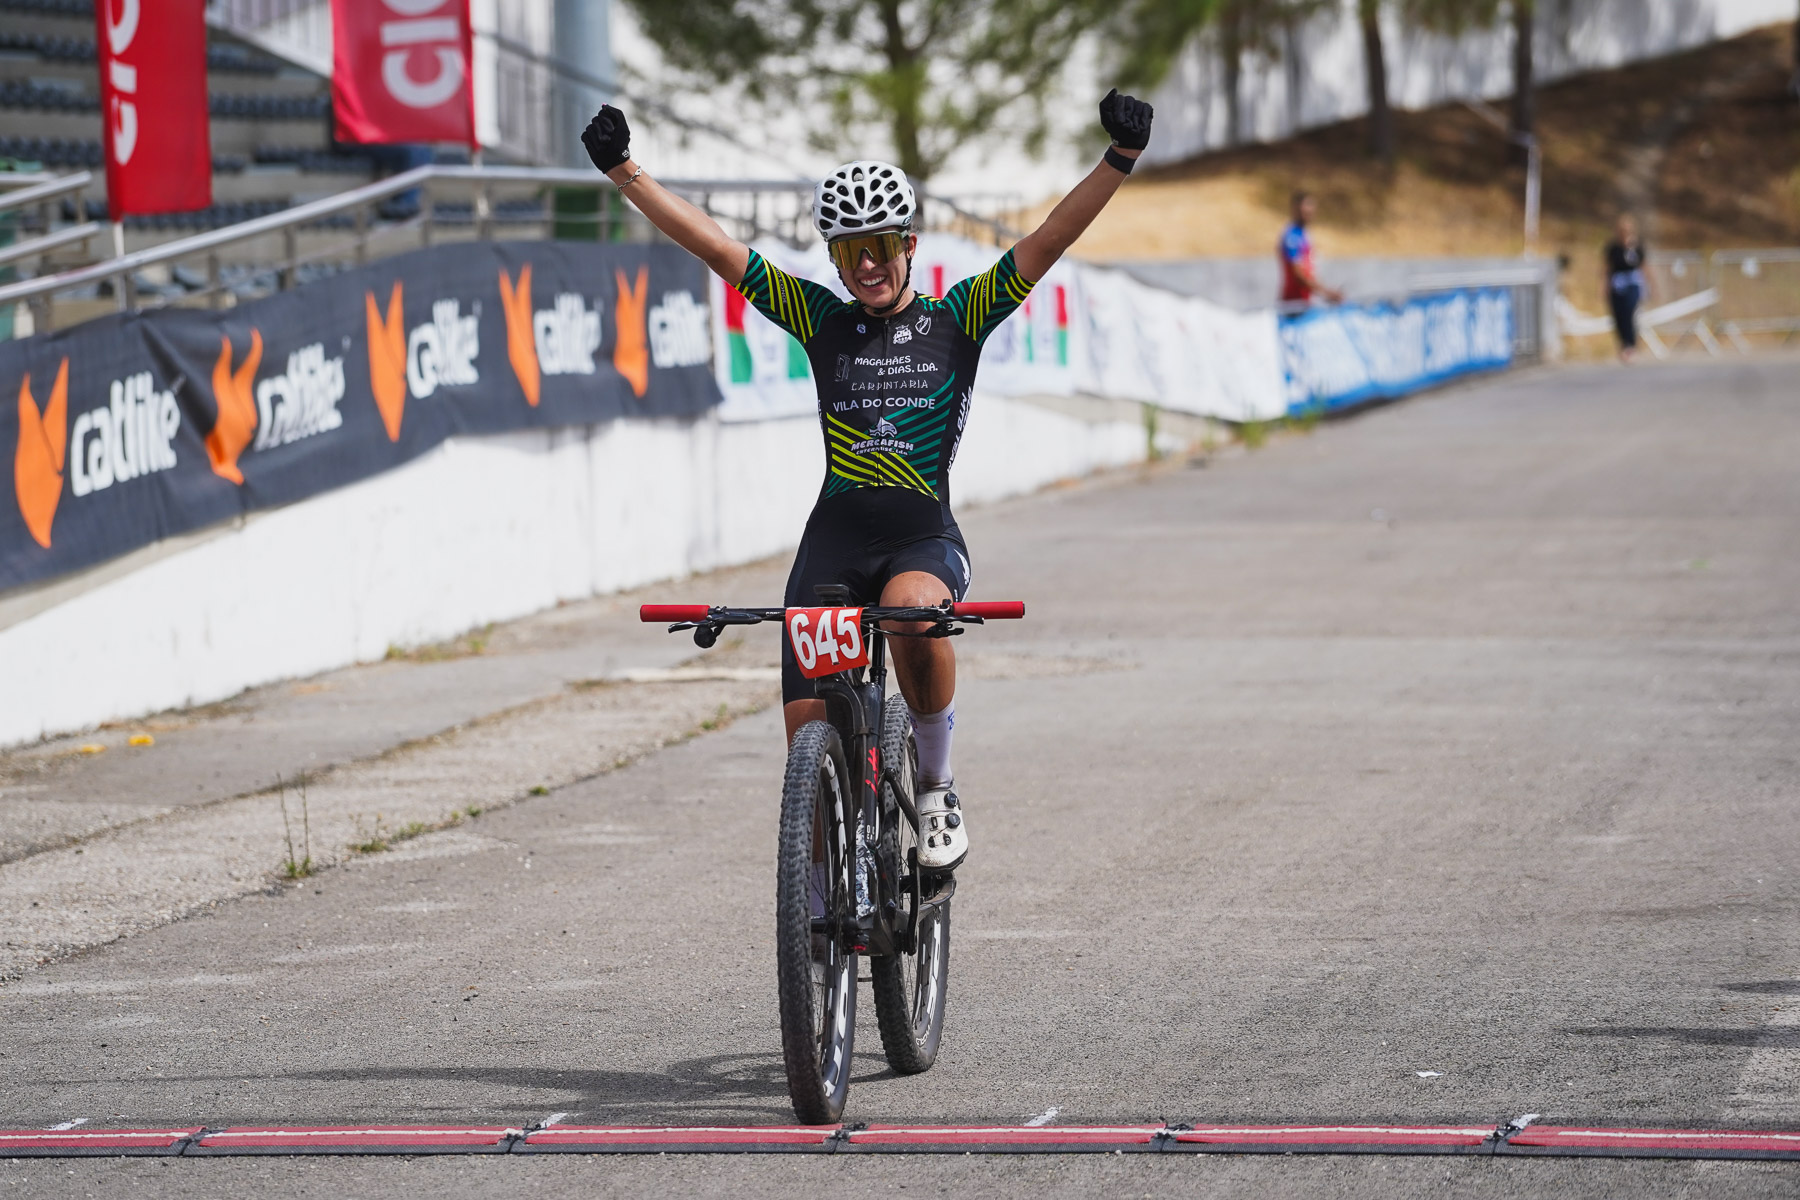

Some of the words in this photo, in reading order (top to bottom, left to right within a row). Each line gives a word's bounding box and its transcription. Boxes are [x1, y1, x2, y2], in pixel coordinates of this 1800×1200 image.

[854, 355, 912, 367] MAGALHÃES
[877, 368, 886, 376] &
[917, 362, 938, 373] LDA.
[851, 379, 929, 391] CARPINTARIA
[833, 400, 859, 412] VILA
[862, 399, 883, 409] DO
[885, 397, 936, 410] CONDE
[851, 438, 914, 452] MERCAFISH
[790, 608, 861, 670] 645
